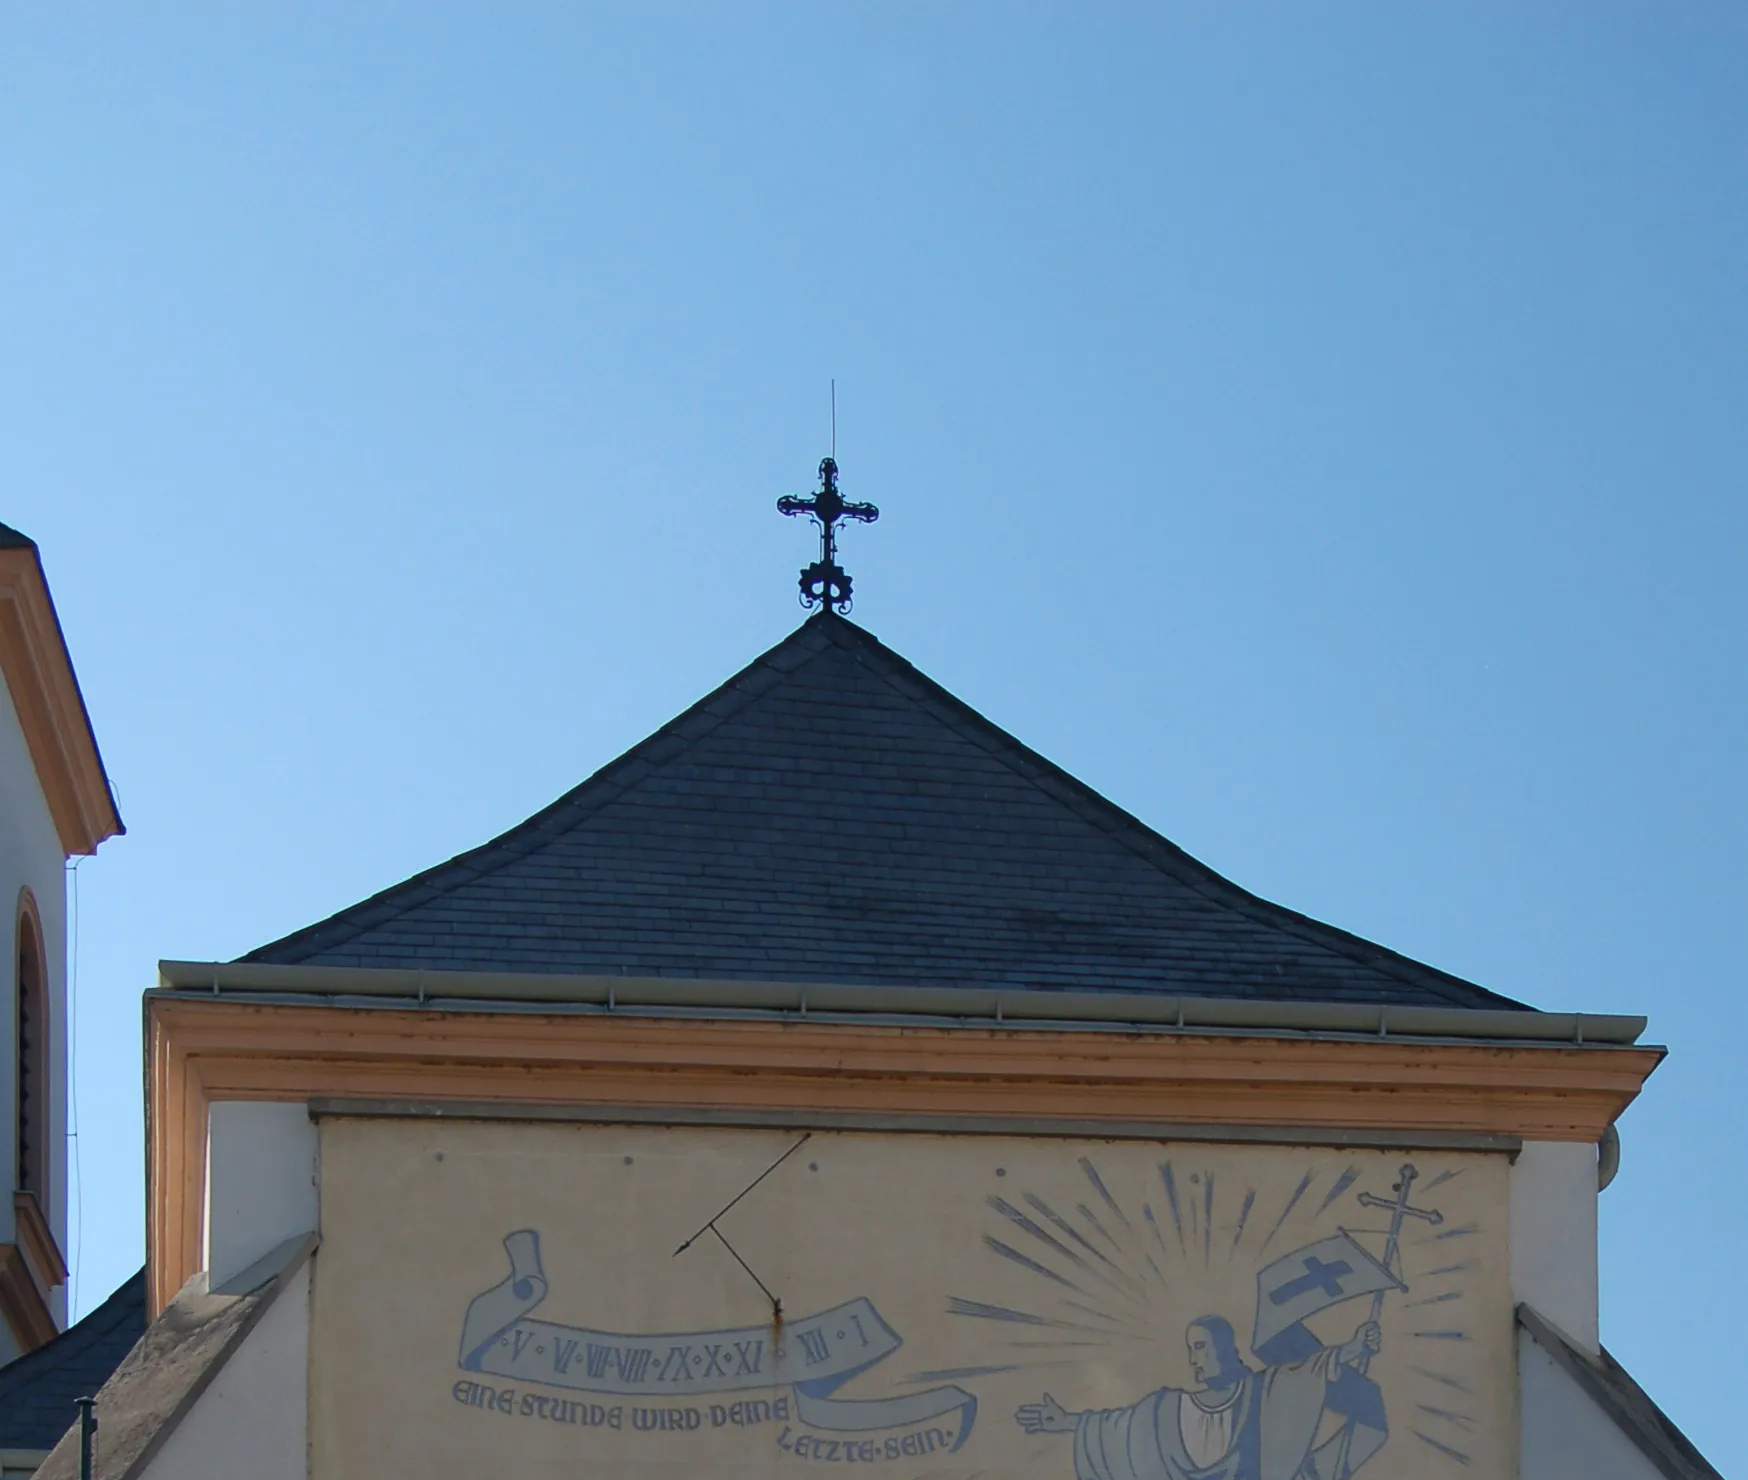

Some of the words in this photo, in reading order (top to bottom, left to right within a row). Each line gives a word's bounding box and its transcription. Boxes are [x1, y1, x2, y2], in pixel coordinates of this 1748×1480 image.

[703, 1343, 726, 1378] X
[733, 1339, 763, 1375] XI
[451, 1378, 516, 1415] EINE
[520, 1392, 623, 1431] STUNDE
[632, 1406, 702, 1431] WIRD
[709, 1396, 790, 1428] DEINE
[776, 1425, 875, 1463] LETZTE
[884, 1427, 949, 1461] SEIN
